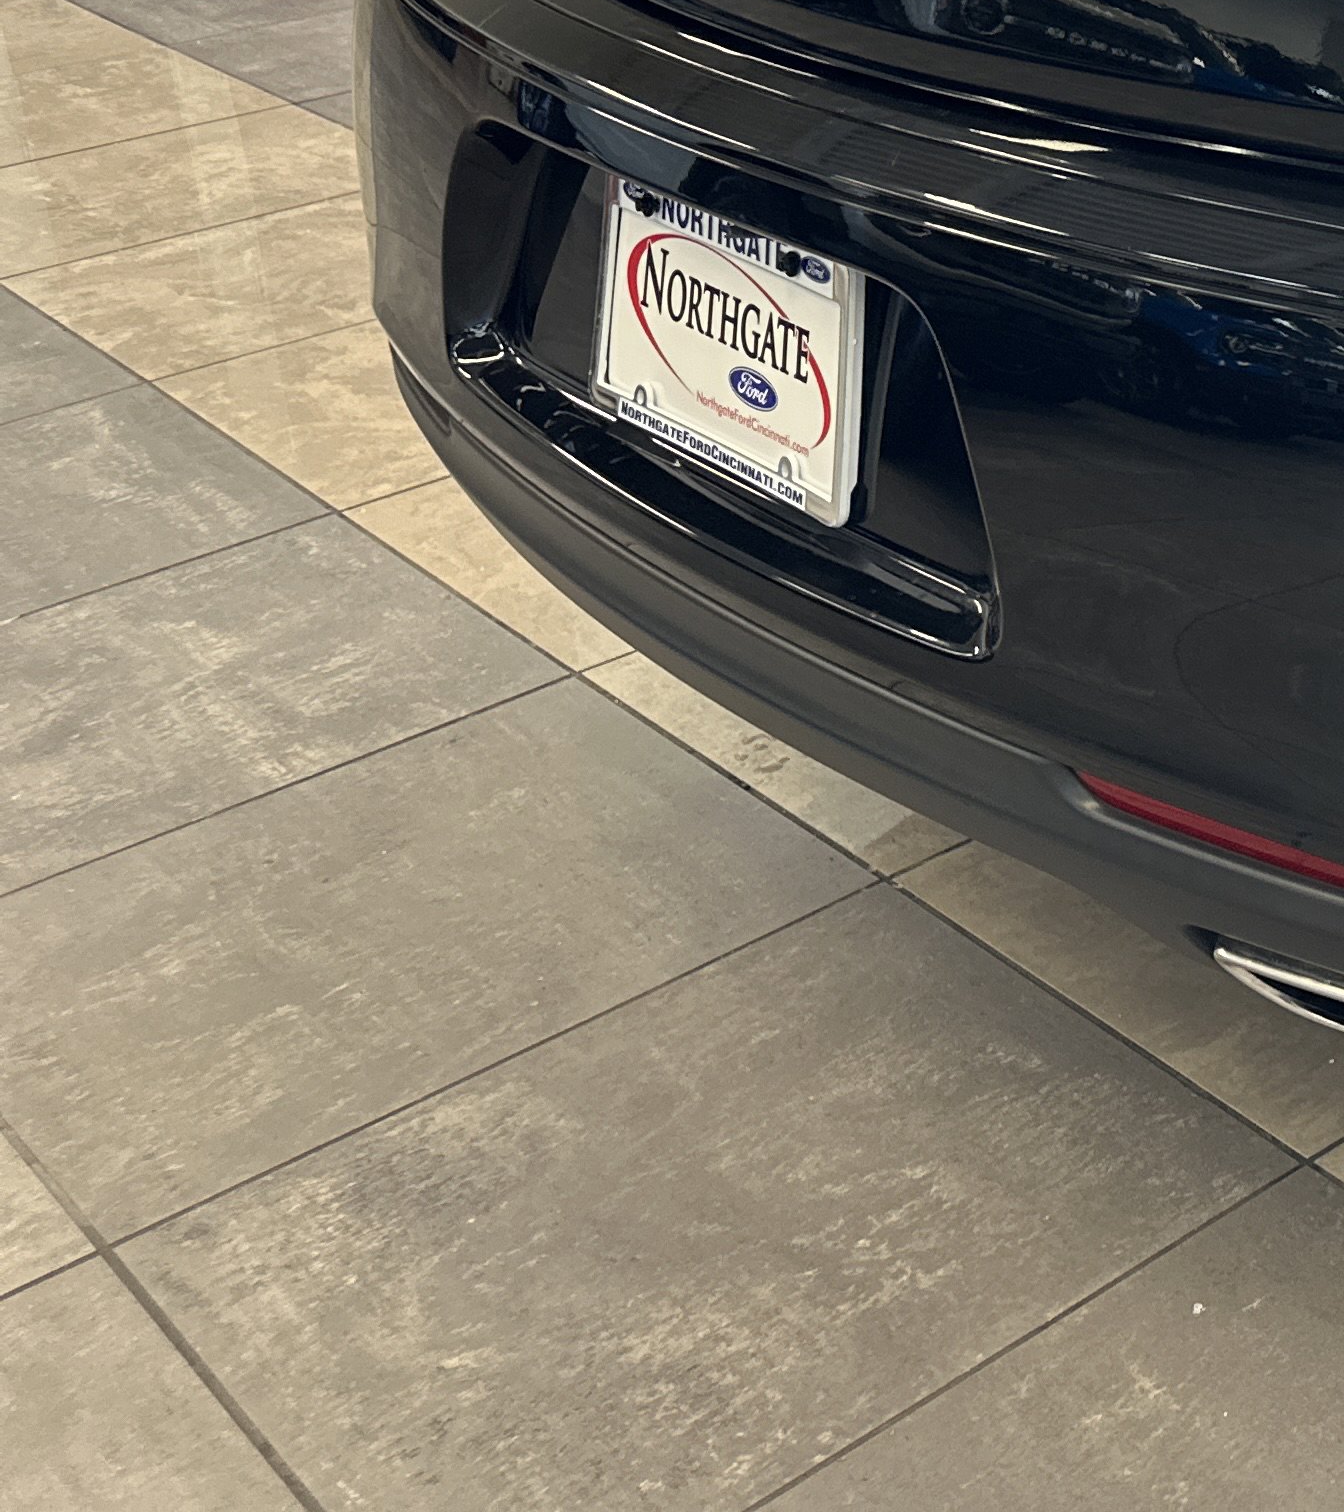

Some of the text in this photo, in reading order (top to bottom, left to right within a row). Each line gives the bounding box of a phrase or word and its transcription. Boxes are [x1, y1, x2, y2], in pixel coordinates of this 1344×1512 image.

[640, 240, 811, 384] NORTHGATE
[736, 371, 769, 406] Ford
[696, 389, 810, 457] NorthgateFordCincinnati.com
